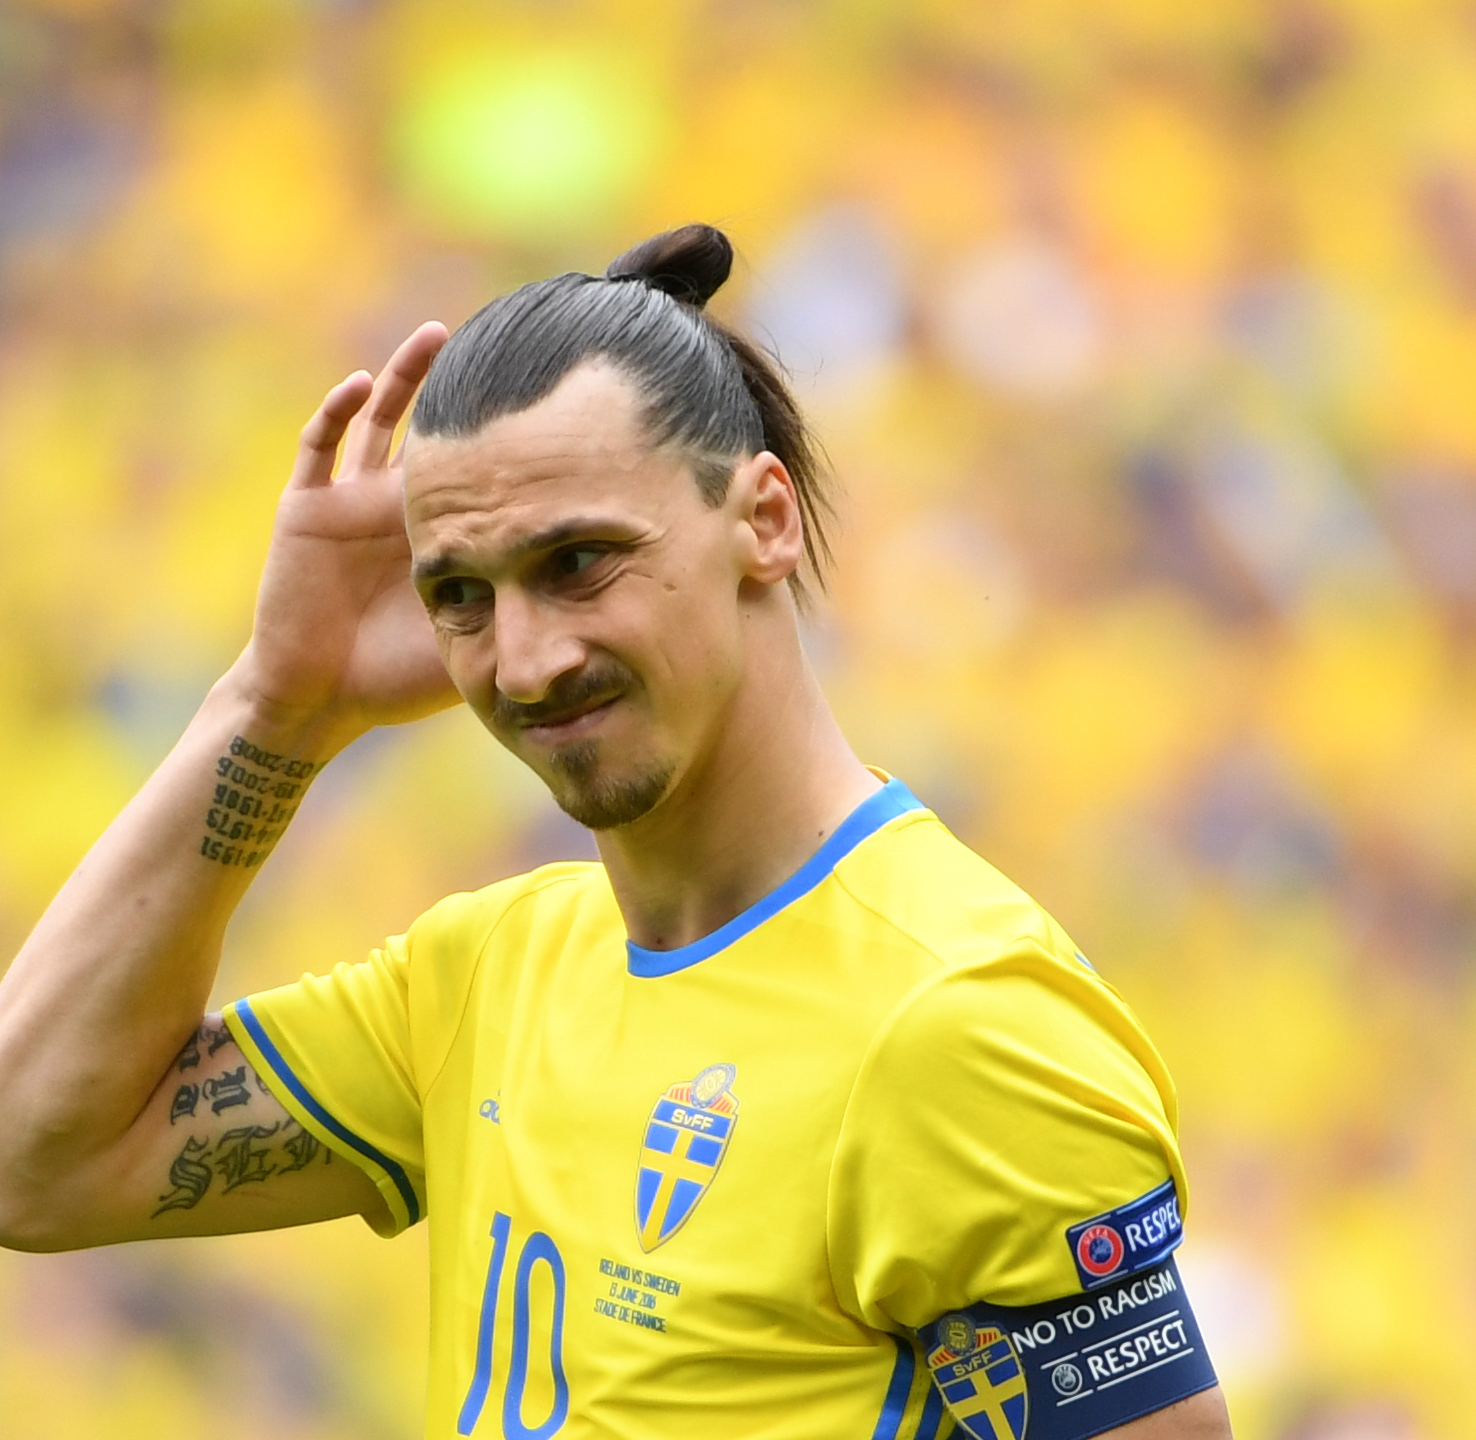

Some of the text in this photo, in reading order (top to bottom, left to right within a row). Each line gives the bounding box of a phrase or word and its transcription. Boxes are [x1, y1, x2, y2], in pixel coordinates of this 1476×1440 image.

[671, 1108, 714, 1130] SvFF
[599, 1258, 681, 1297] IRELAND VS SWEDEN
[617, 1286, 639, 1304] JUNE
[594, 1298, 666, 1333] STADE DE FRANCE
[1011, 1269, 1177, 1353] NO TO RACISM
[953, 1350, 992, 1376] SvFF
[1087, 1319, 1188, 1381] RESPECT
